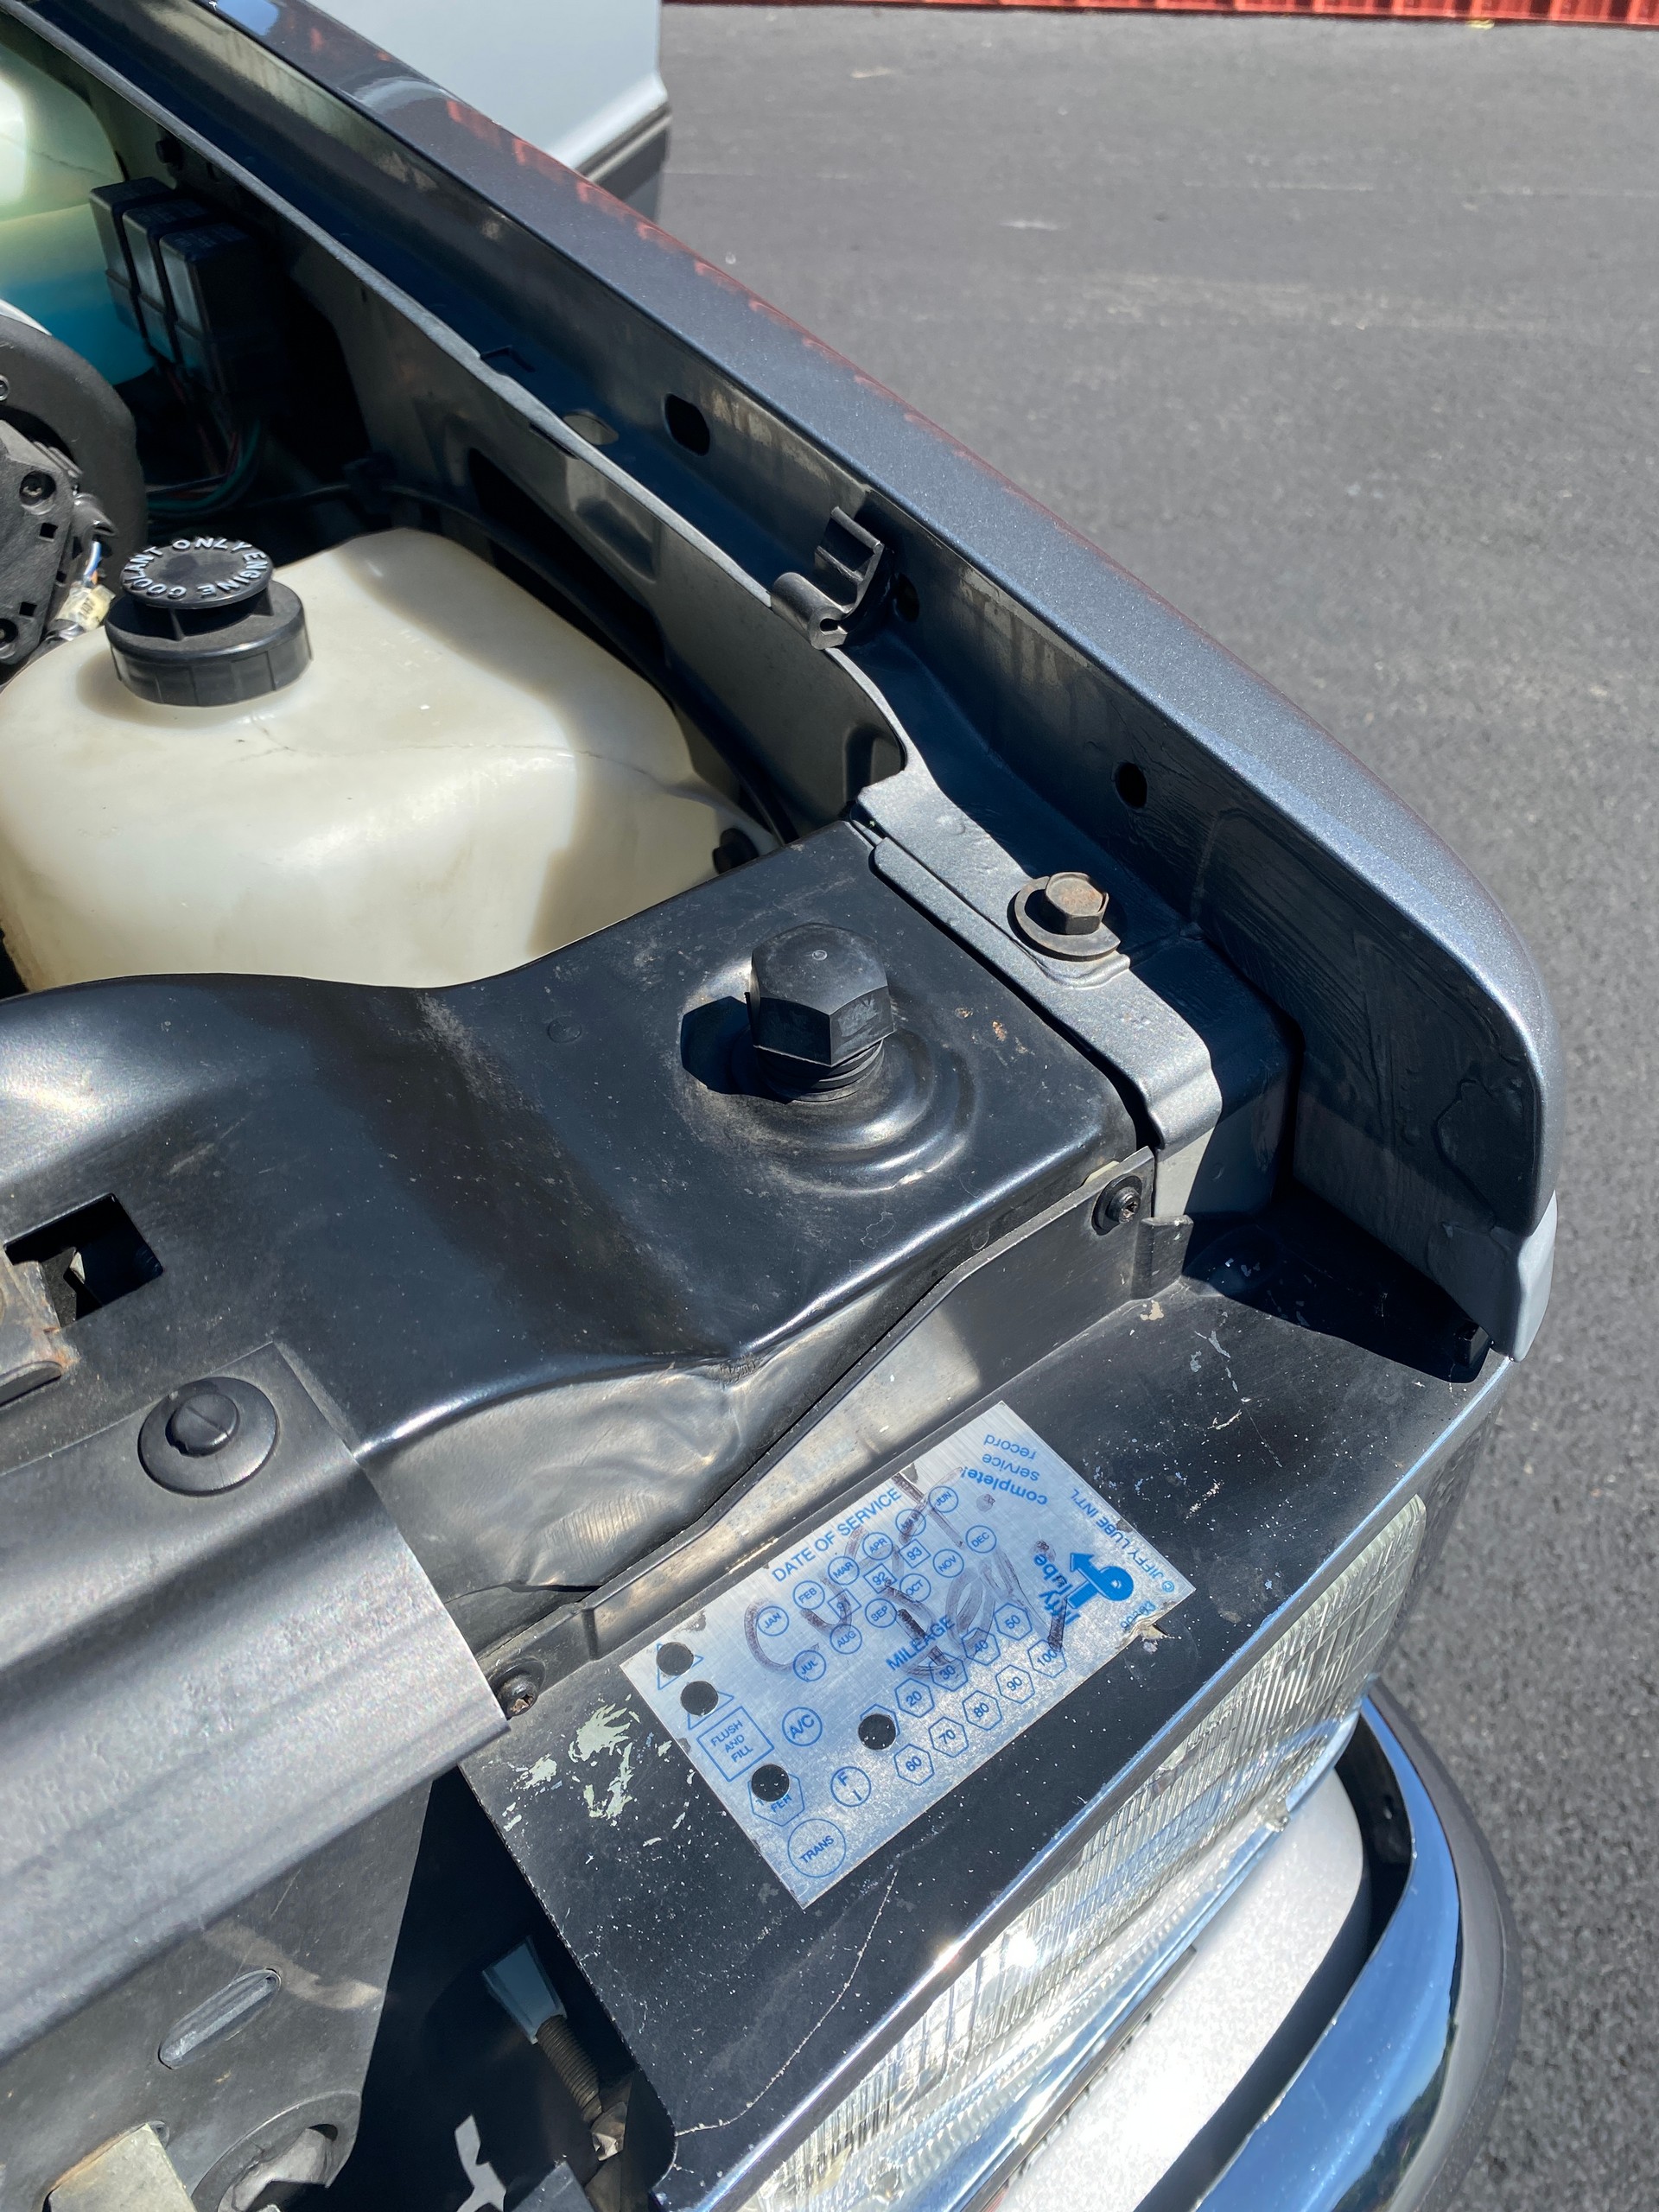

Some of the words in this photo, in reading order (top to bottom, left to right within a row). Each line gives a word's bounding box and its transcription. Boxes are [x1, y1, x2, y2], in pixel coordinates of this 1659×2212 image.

[173, 536, 252, 552] ONLY
[123, 545, 187, 599] COOLANT
[197, 550, 268, 598] ENGINE
[983, 1433, 1037, 1460] record
[982, 1453, 1040, 1481] service
[961, 1466, 1048, 1506] complete!
[935, 1491, 952, 1506] JUN
[772, 1547, 817, 1582] DATE
[813, 1532, 837, 1552] OF
[837, 1487, 902, 1537] SERVICE
[970, 1531, 990, 1548] DEC
[1096, 1516, 1131, 1549] LUBE
[869, 1537, 888, 1554] APR
[906, 1547, 923, 1561] 93
[833, 1561, 855, 1579] MAR
[938, 1555, 957, 1572] NOV
[1129, 1548, 1165, 1580] JIFFY
[871, 1571, 887, 1586] 92
[798, 1587, 817, 1603] FEB
[907, 1580, 925, 1596] OCT
[763, 1613, 782, 1629] JAN
[870, 1605, 888, 1621] SEP
[1005, 1614, 1021, 1629] 50
[837, 1630, 856, 1648] AUG
[886, 1616, 955, 1671] MILEAGE
[974, 1641, 988, 1654] 40
[1036, 1649, 1058, 1668] 100
[800, 1660, 818, 1675] JUL
[938, 1665, 957, 1680] 30
[1006, 1676, 1023, 1691] 90
[906, 1692, 923, 1707] 20
[973, 1702, 990, 1718] 80
[710, 1719, 743, 1746] FLUSH
[790, 1714, 815, 1740] A/C
[724, 1735, 745, 1753] AND
[938, 1730, 957, 1745] 70
[731, 1745, 753, 1763] FILL
[906, 1756, 923, 1771] 60
[800, 1835, 835, 1863] TRANS
